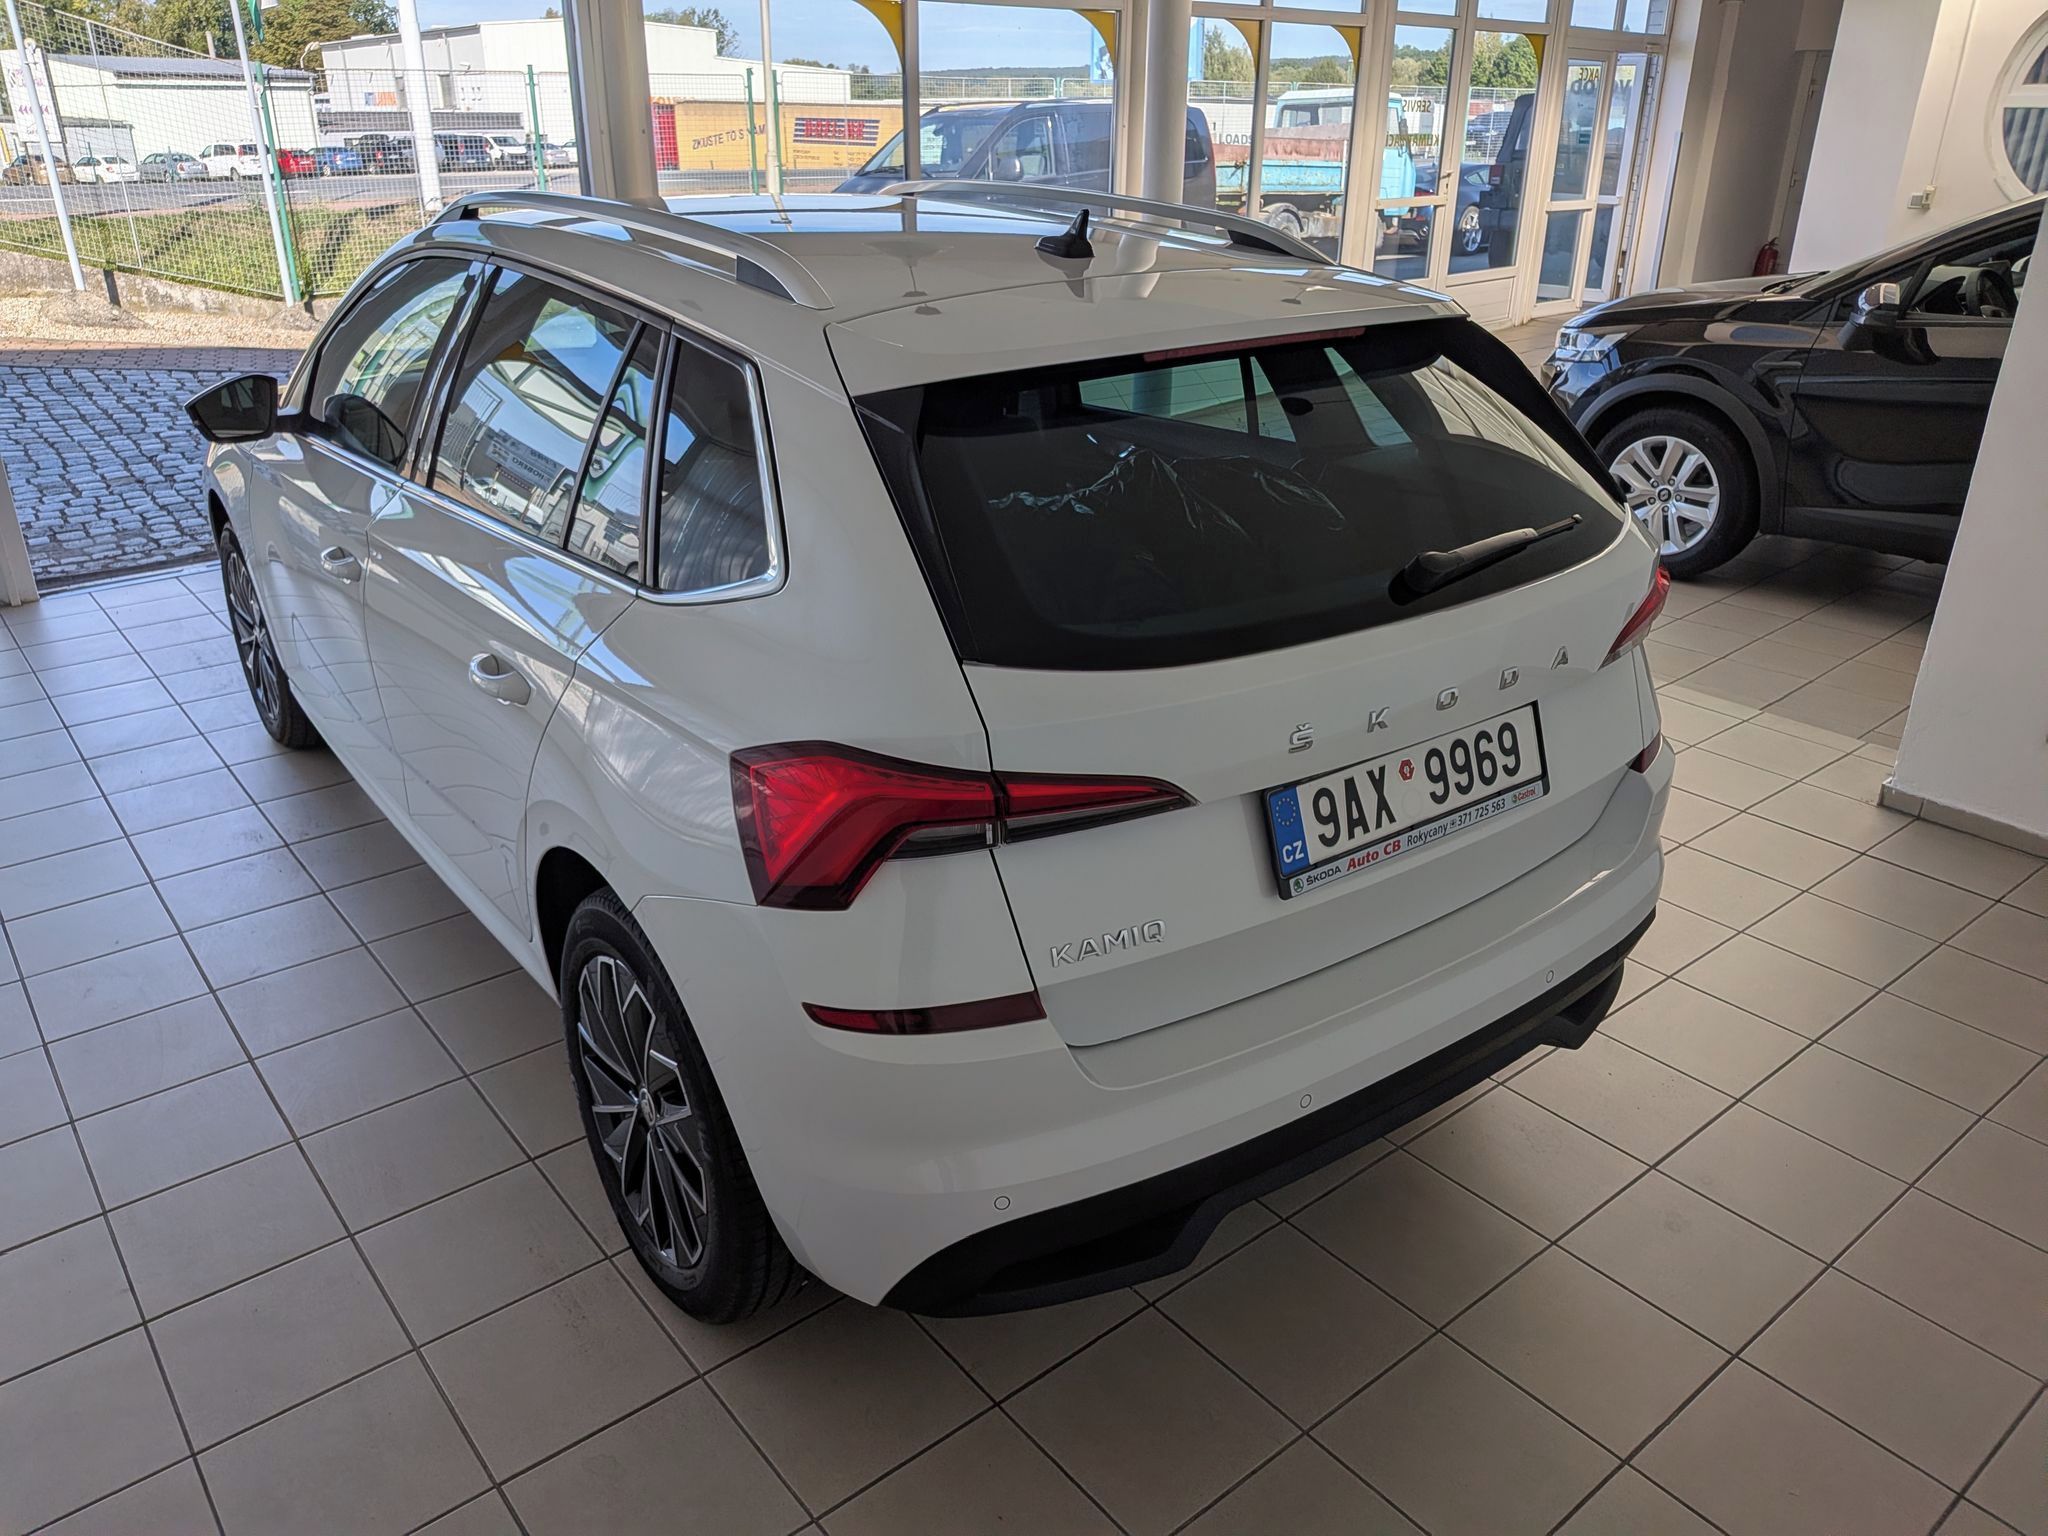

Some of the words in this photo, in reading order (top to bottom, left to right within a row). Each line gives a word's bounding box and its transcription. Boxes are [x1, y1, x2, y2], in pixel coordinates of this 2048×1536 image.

[1288, 646, 1569, 754] ŠKODA
[1312, 764, 1397, 848] 9AX
[1424, 721, 1521, 805] 9969
[1282, 840, 1305, 864] CZ
[1306, 865, 1342, 886] ŠKODA
[1346, 850, 1380, 872] Auto
[1383, 839, 1402, 856] CB
[1406, 821, 1449, 847] Rokycany
[1457, 811, 1473, 827] 371
[1474, 804, 1490, 820] 725
[1491, 798, 1506, 813] 563
[1517, 786, 1536, 802] Castrol
[1049, 918, 1167, 968] KAMIQ
